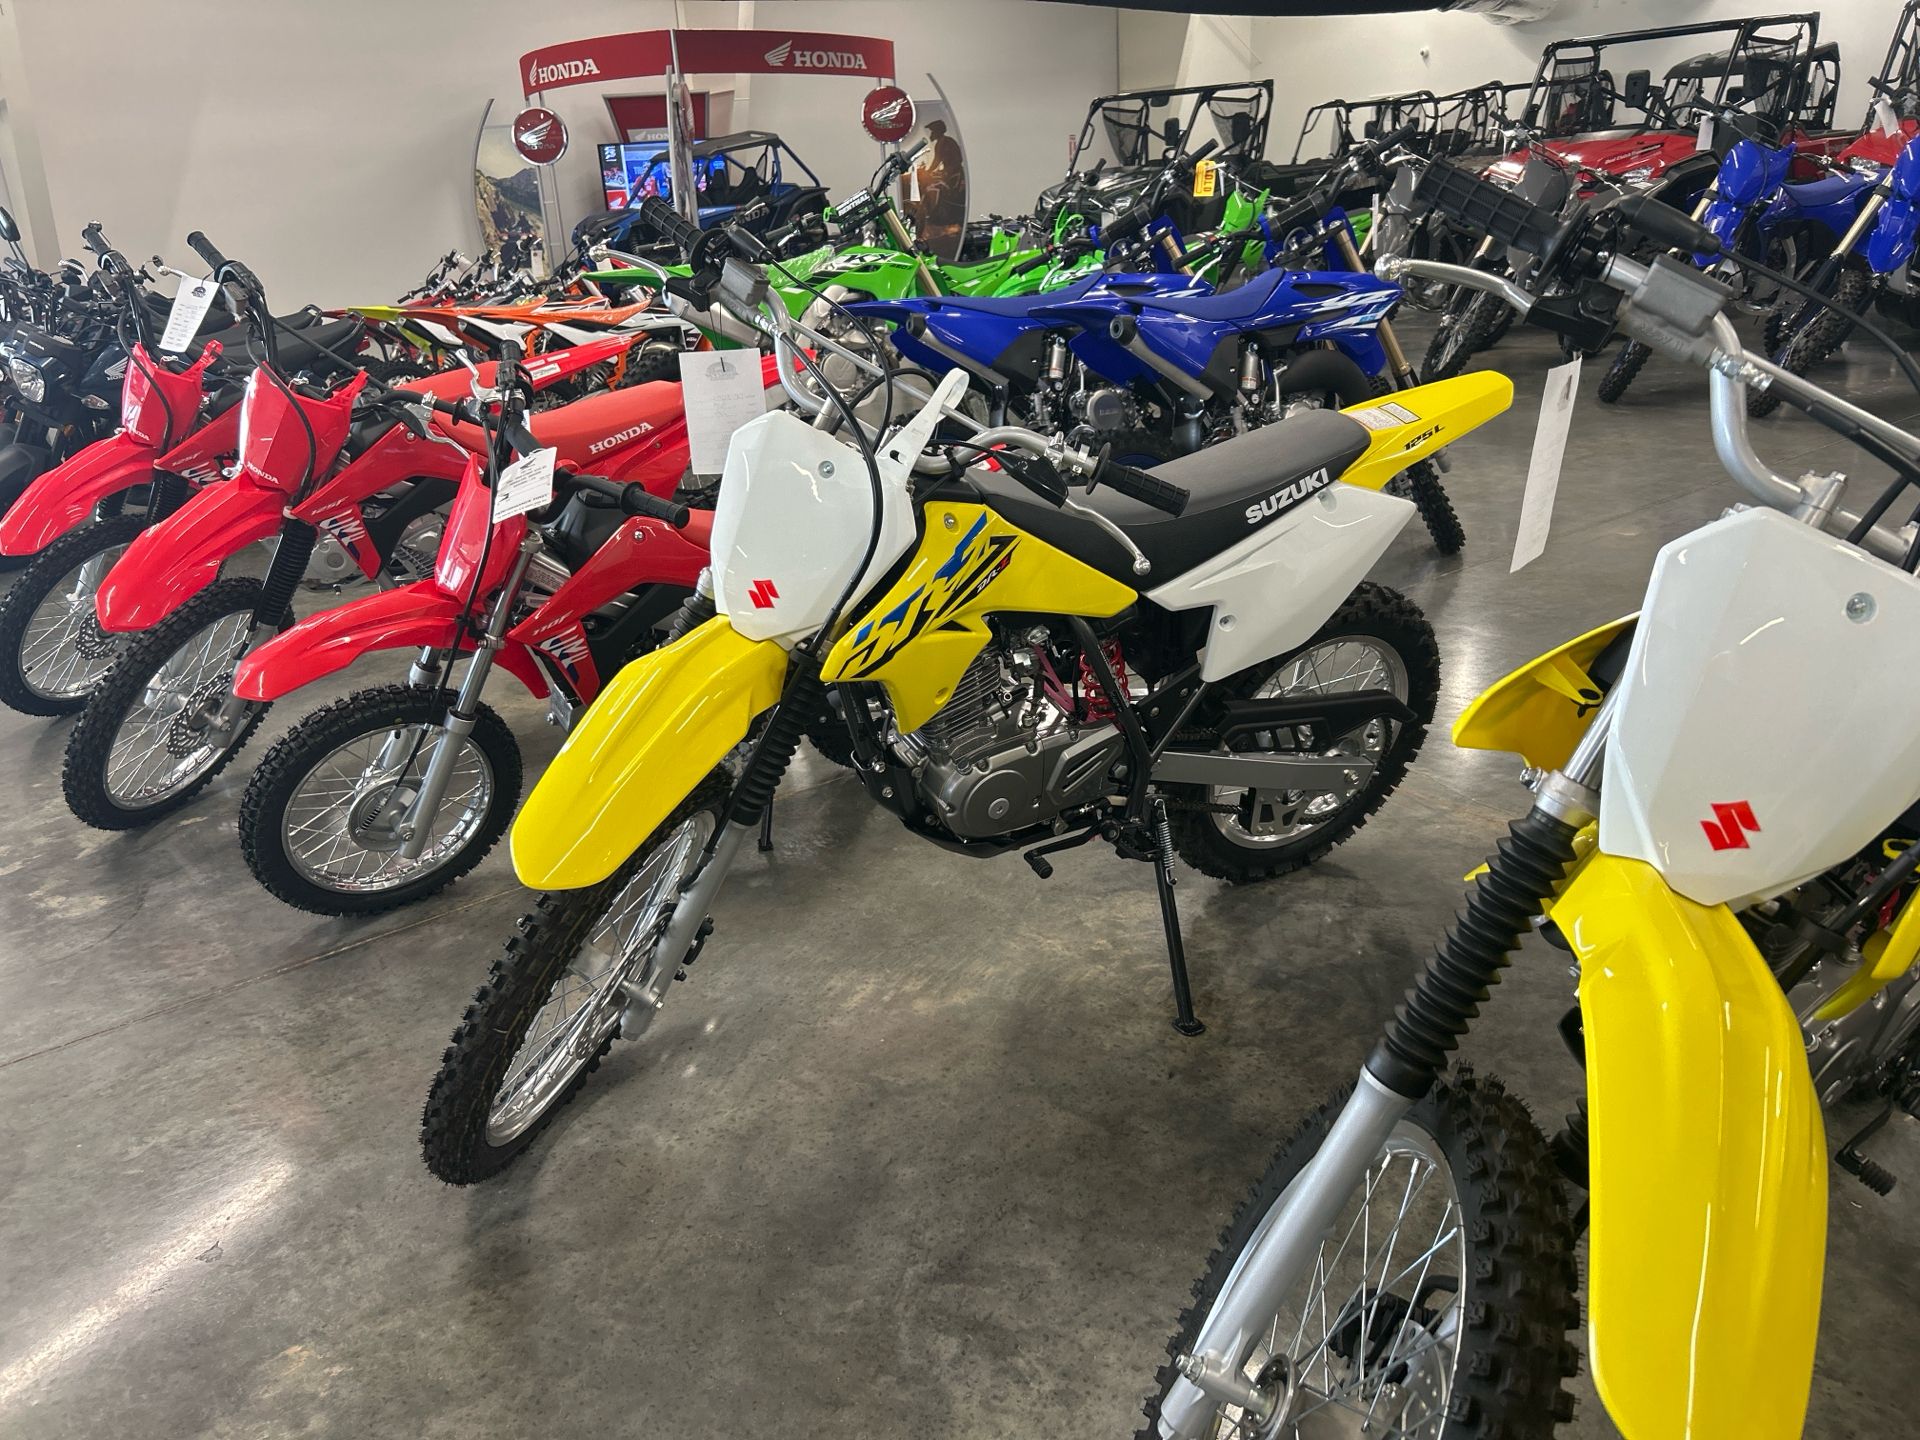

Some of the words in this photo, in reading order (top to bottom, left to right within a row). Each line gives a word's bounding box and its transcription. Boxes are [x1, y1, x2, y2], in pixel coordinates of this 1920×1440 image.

[538, 58, 600, 84] HONDA
[794, 50, 867, 70] HONDA
[646, 132, 668, 141] HON
[720, 206, 770, 229] HNDA
[589, 422, 655, 454] HONDA
[246, 461, 280, 485] HONDA
[1245, 467, 1330, 525] SUZUKI
